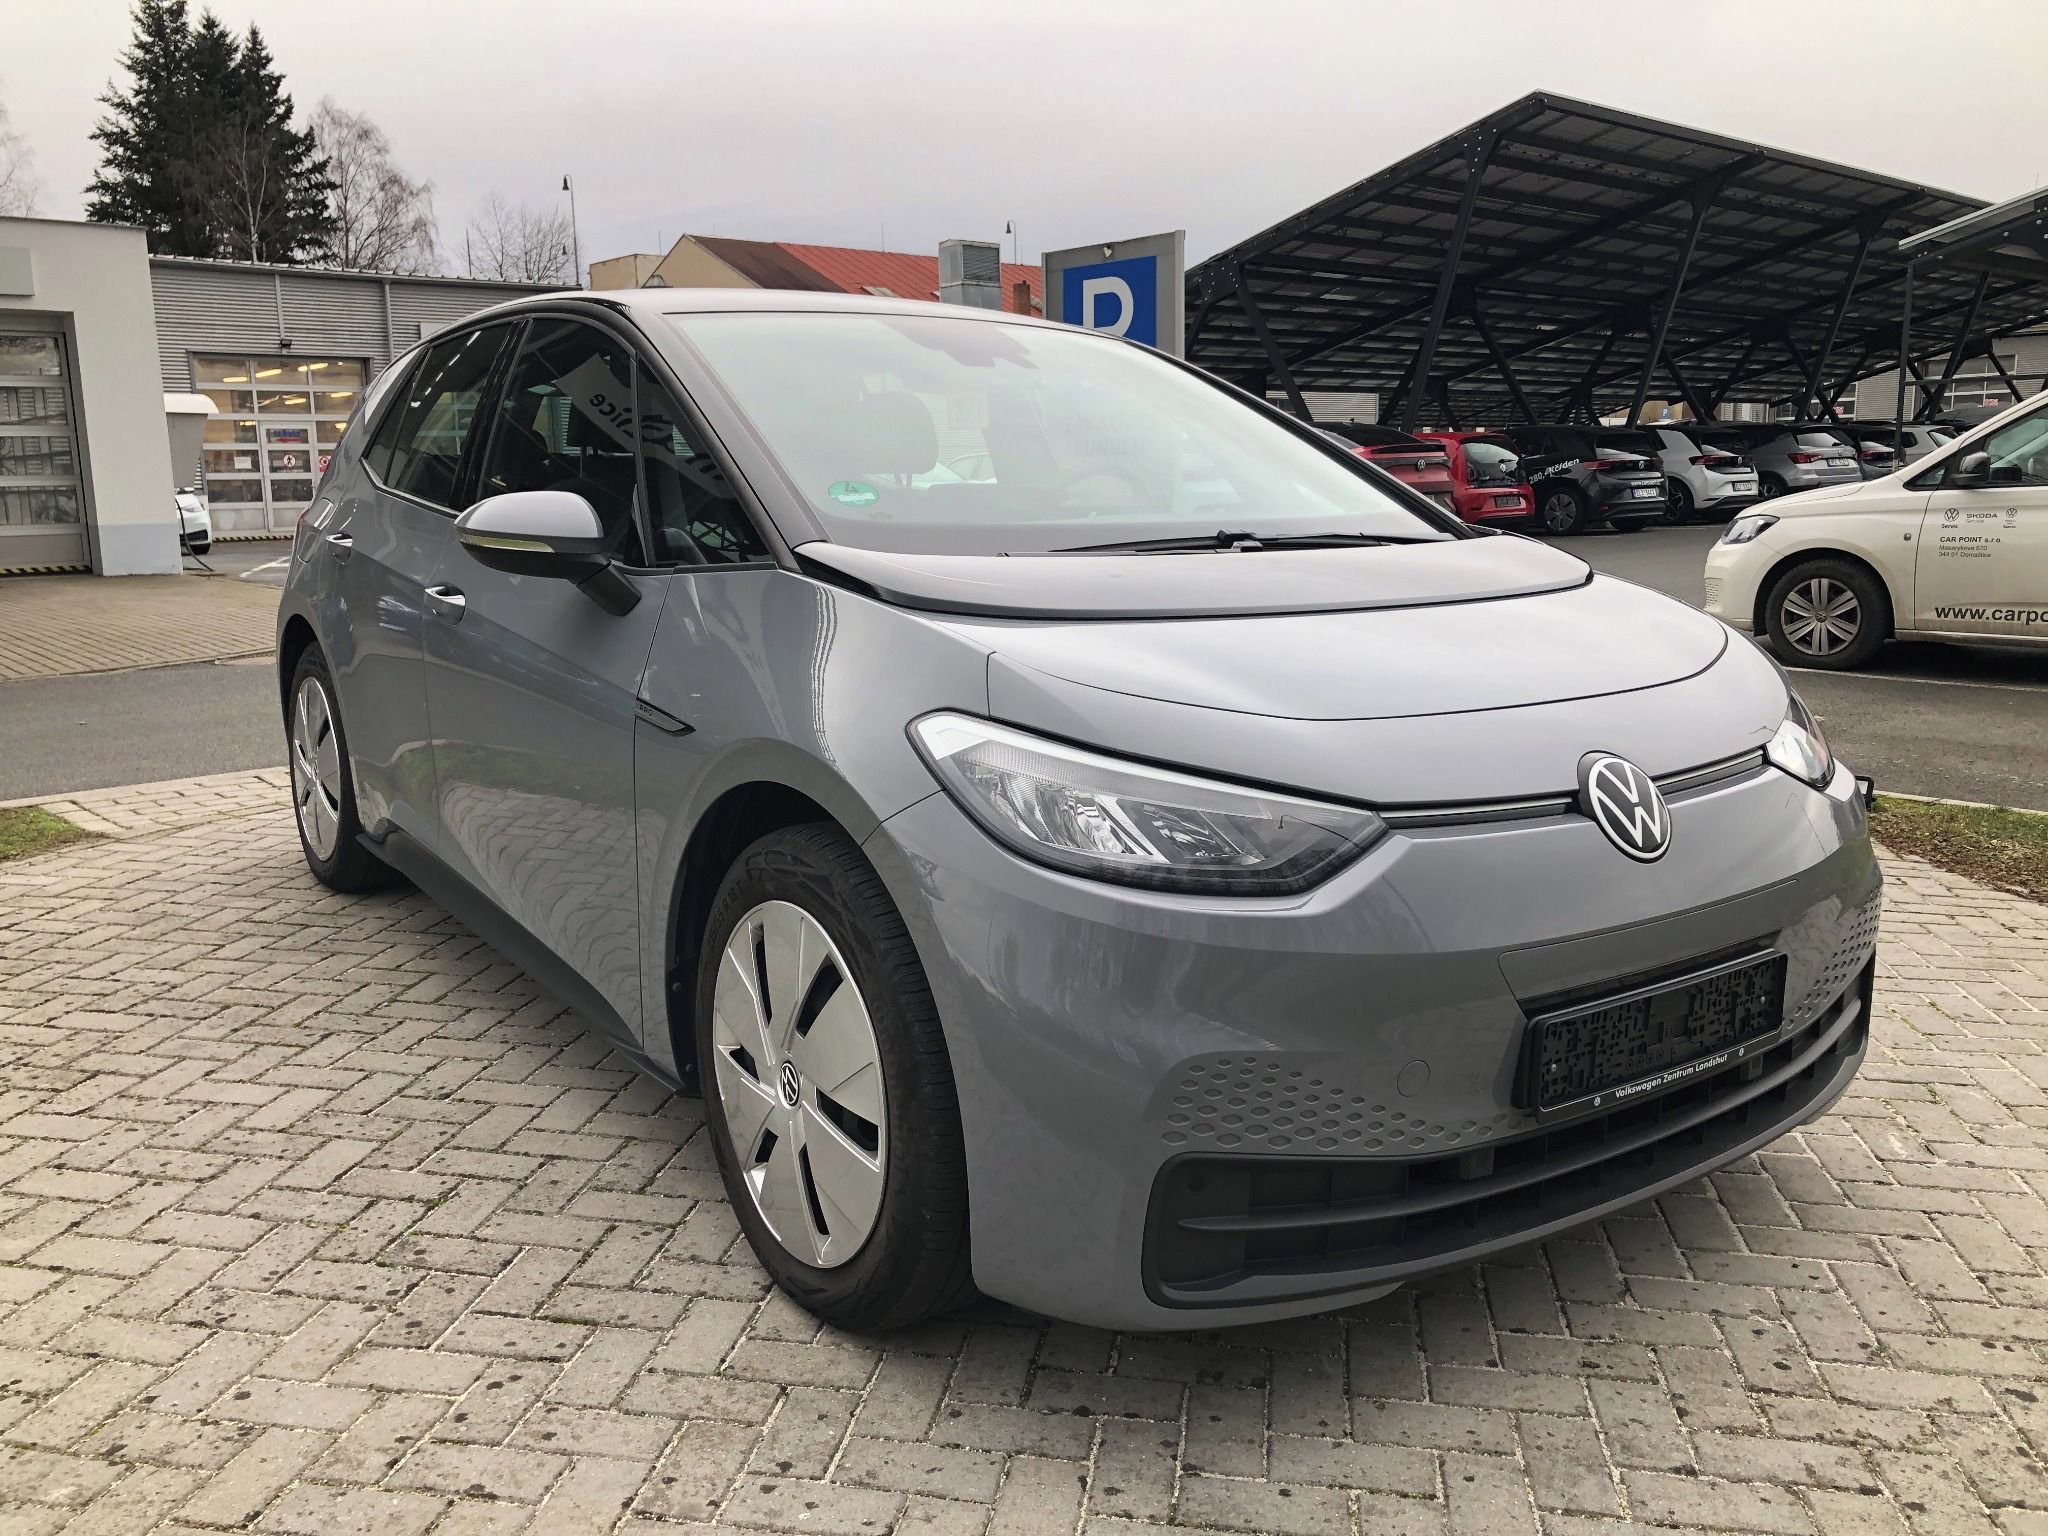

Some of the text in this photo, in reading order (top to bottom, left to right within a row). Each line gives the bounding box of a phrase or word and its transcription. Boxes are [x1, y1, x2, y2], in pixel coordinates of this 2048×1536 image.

[1662, 408, 1668, 417] P
[1615, 1053, 1728, 1099] Volkswagen Zentrum Landshut
